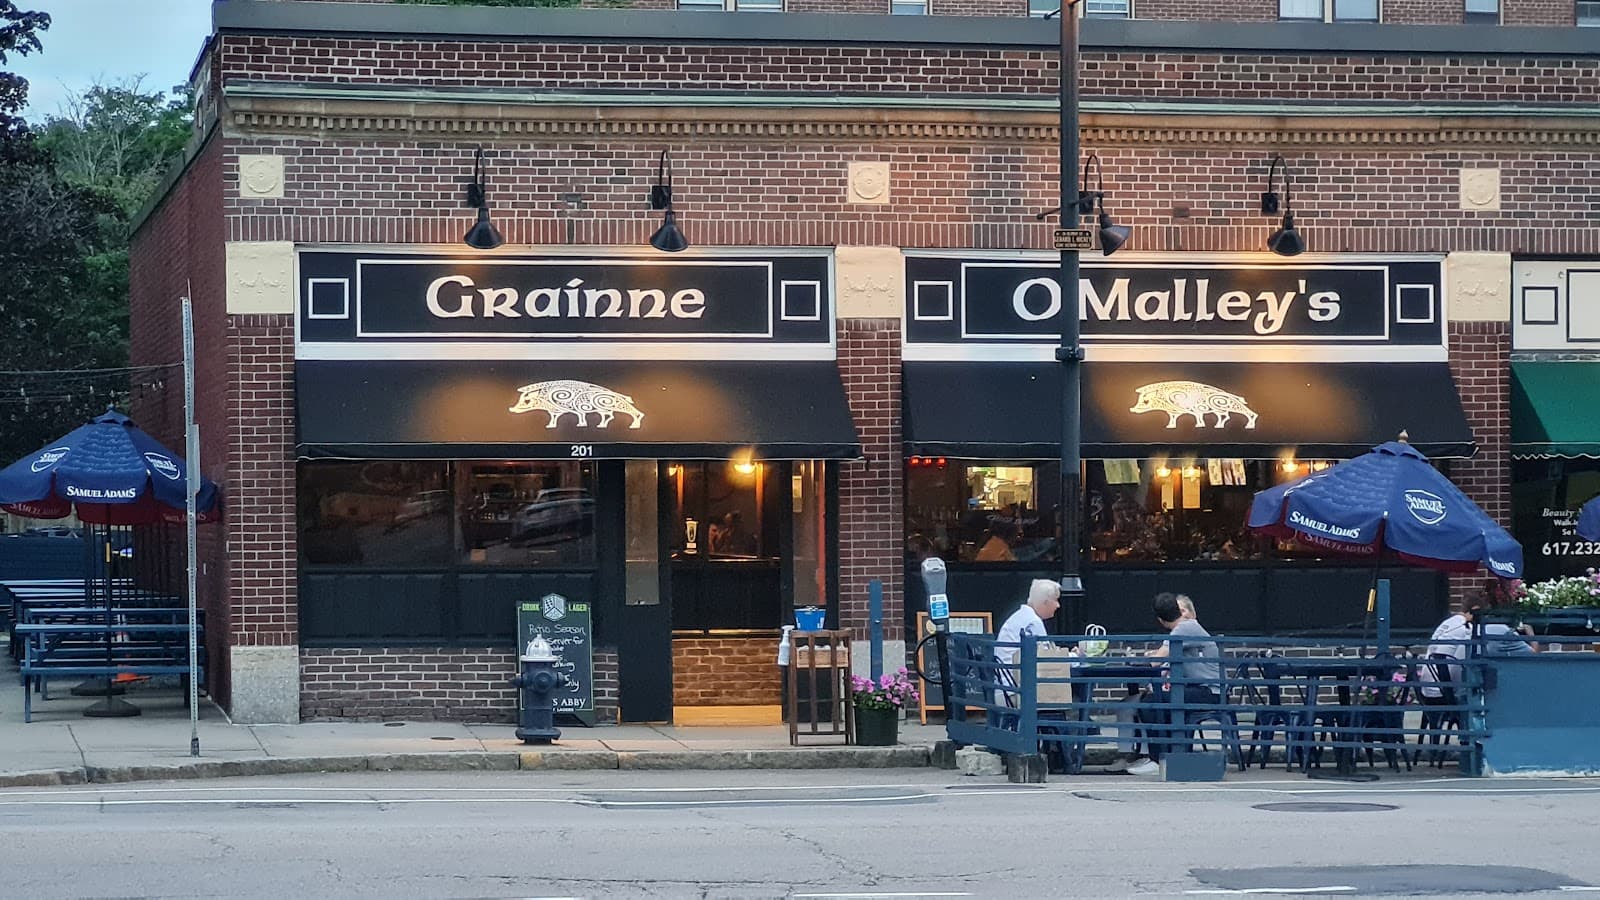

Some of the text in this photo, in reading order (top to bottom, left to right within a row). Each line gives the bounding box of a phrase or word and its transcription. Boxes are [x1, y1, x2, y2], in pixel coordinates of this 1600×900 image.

[571, 445, 593, 457] 201
[66, 486, 136, 498] SAMUEL ADAMS
[1405, 493, 1446, 509] SAMUEL
[1542, 507, 1575, 520] Beauty
[1290, 511, 1328, 533] SAMUEL
[1542, 541, 1600, 556] 617.232
[561, 698, 586, 709] ABBY
